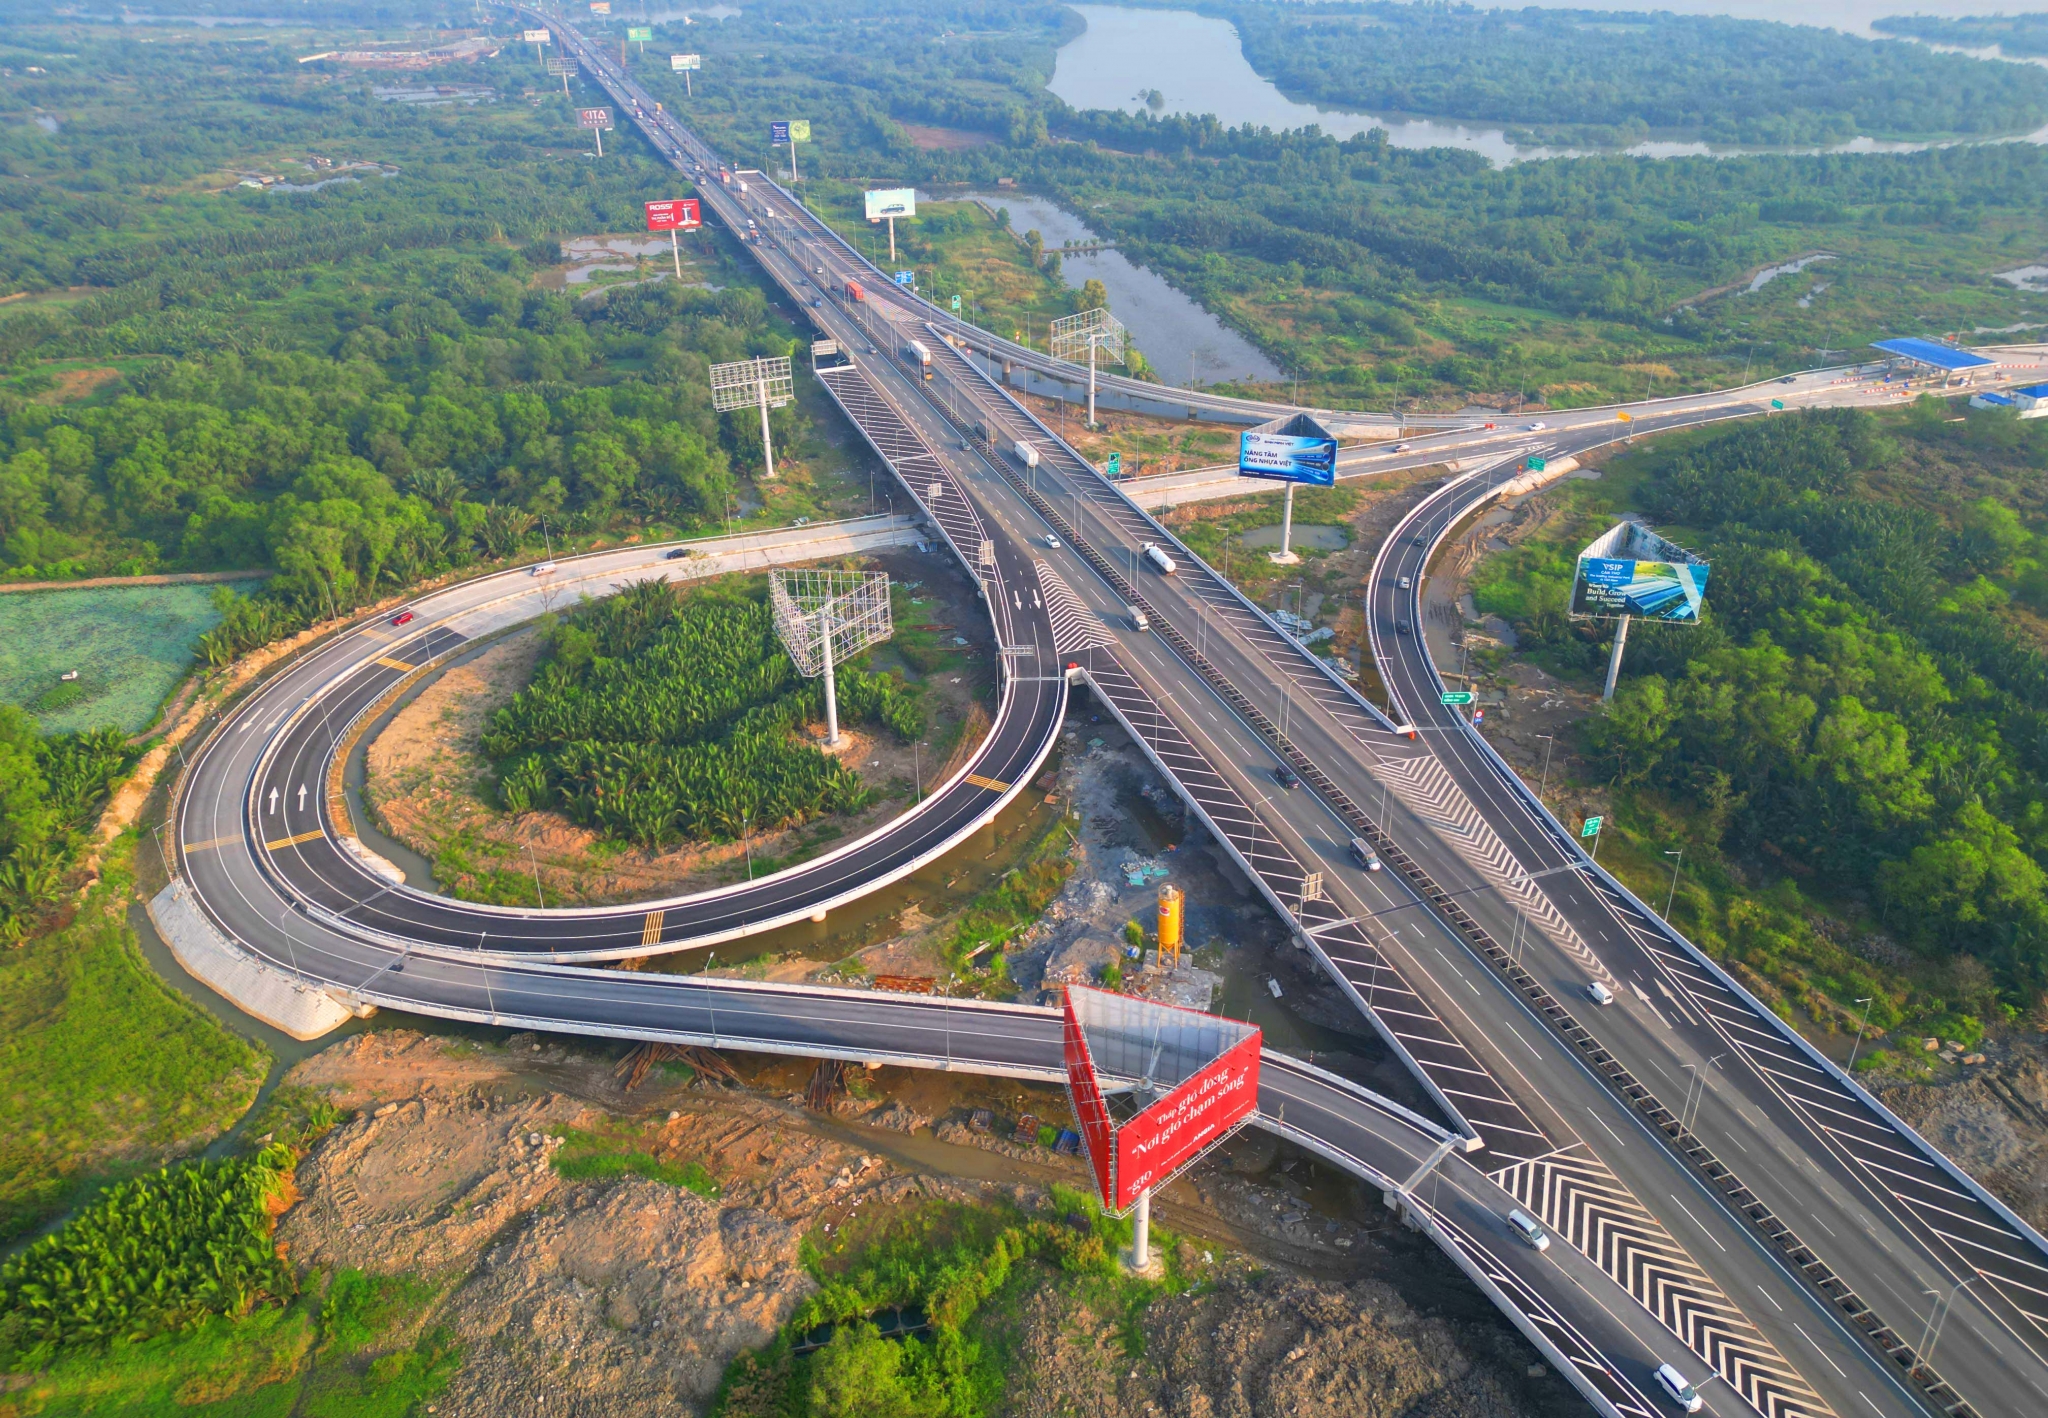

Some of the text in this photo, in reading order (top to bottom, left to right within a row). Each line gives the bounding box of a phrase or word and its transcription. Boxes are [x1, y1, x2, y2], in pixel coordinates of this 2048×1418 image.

[582, 110, 607, 119] KITA
[1244, 449, 1263, 457] NÂNG
[1259, 458, 1278, 466] NHỰA
[1602, 563, 1624, 571] VSIP
[1161, 1117, 1181, 1145] gió
[1183, 1096, 1215, 1124] chạm
